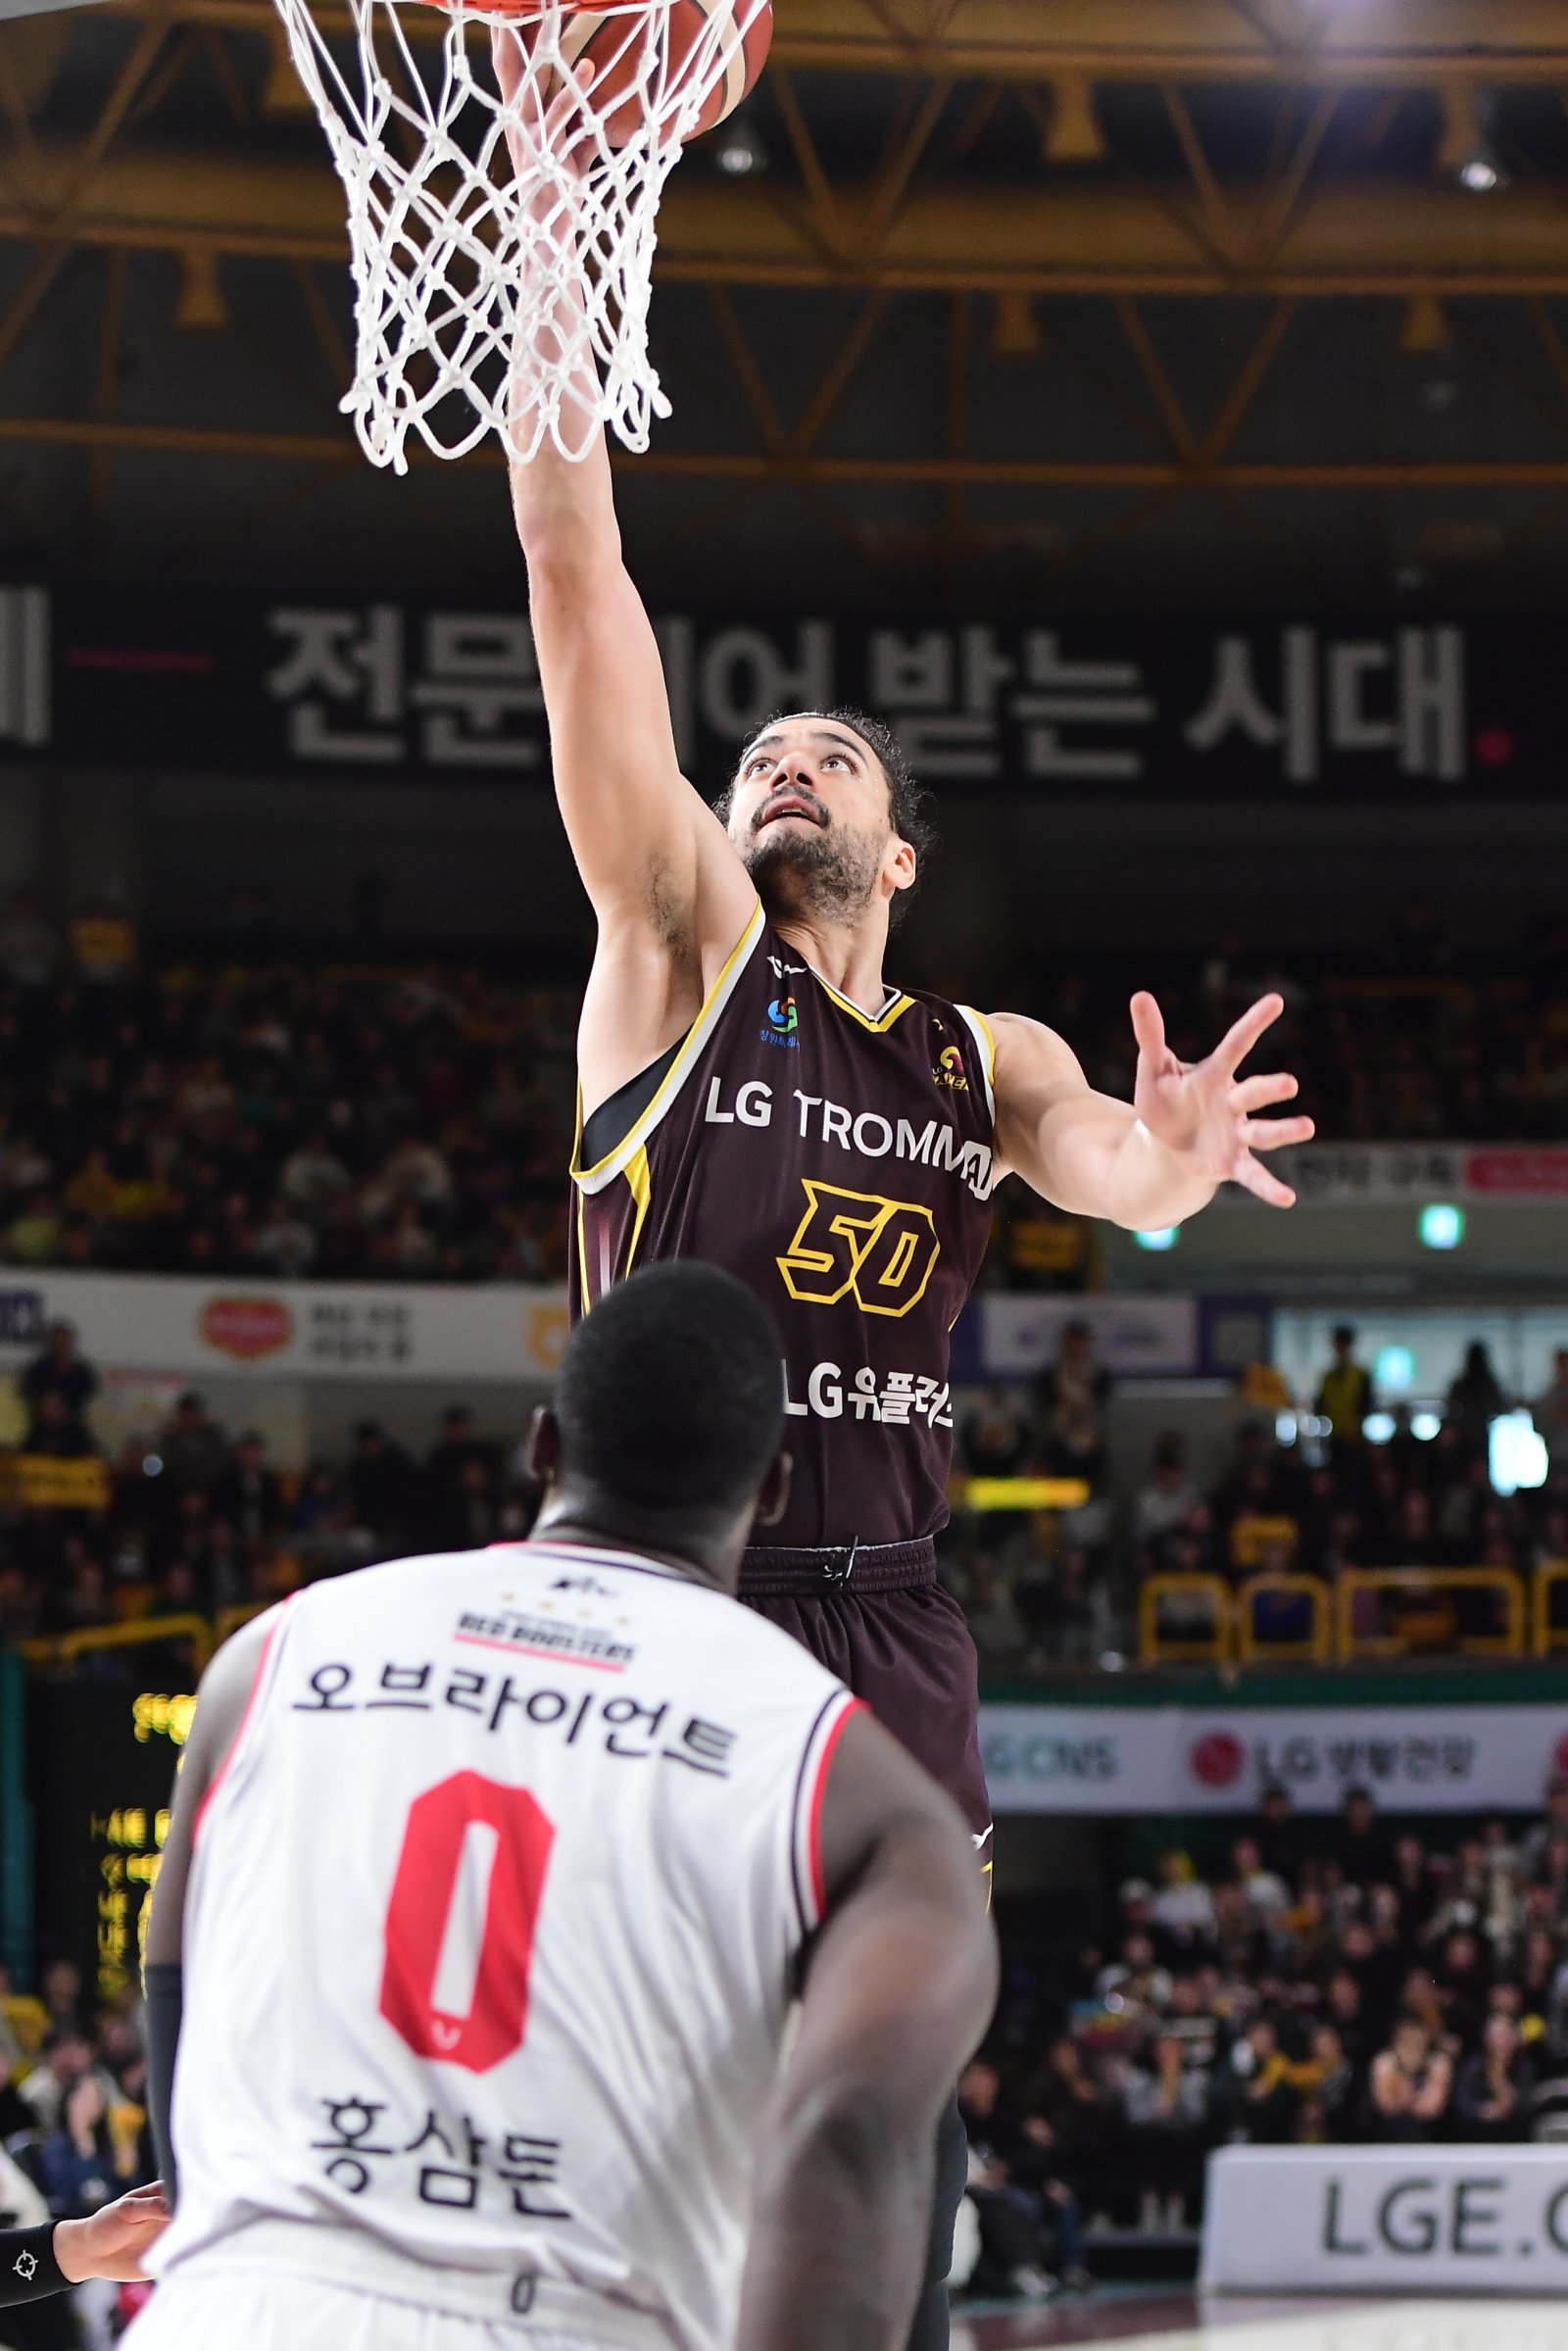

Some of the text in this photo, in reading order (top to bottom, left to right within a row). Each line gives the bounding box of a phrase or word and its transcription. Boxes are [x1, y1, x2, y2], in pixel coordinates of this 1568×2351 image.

[270, 608, 836, 766] 전문어
[869, 623, 1156, 778] 받는
[705, 1076, 773, 1127] LG
[793, 1089, 969, 1180] TROMM
[775, 1178, 941, 1318] 50
[291, 1662, 738, 1778] 오브라이언트
[379, 1768, 556, 2075] 0
